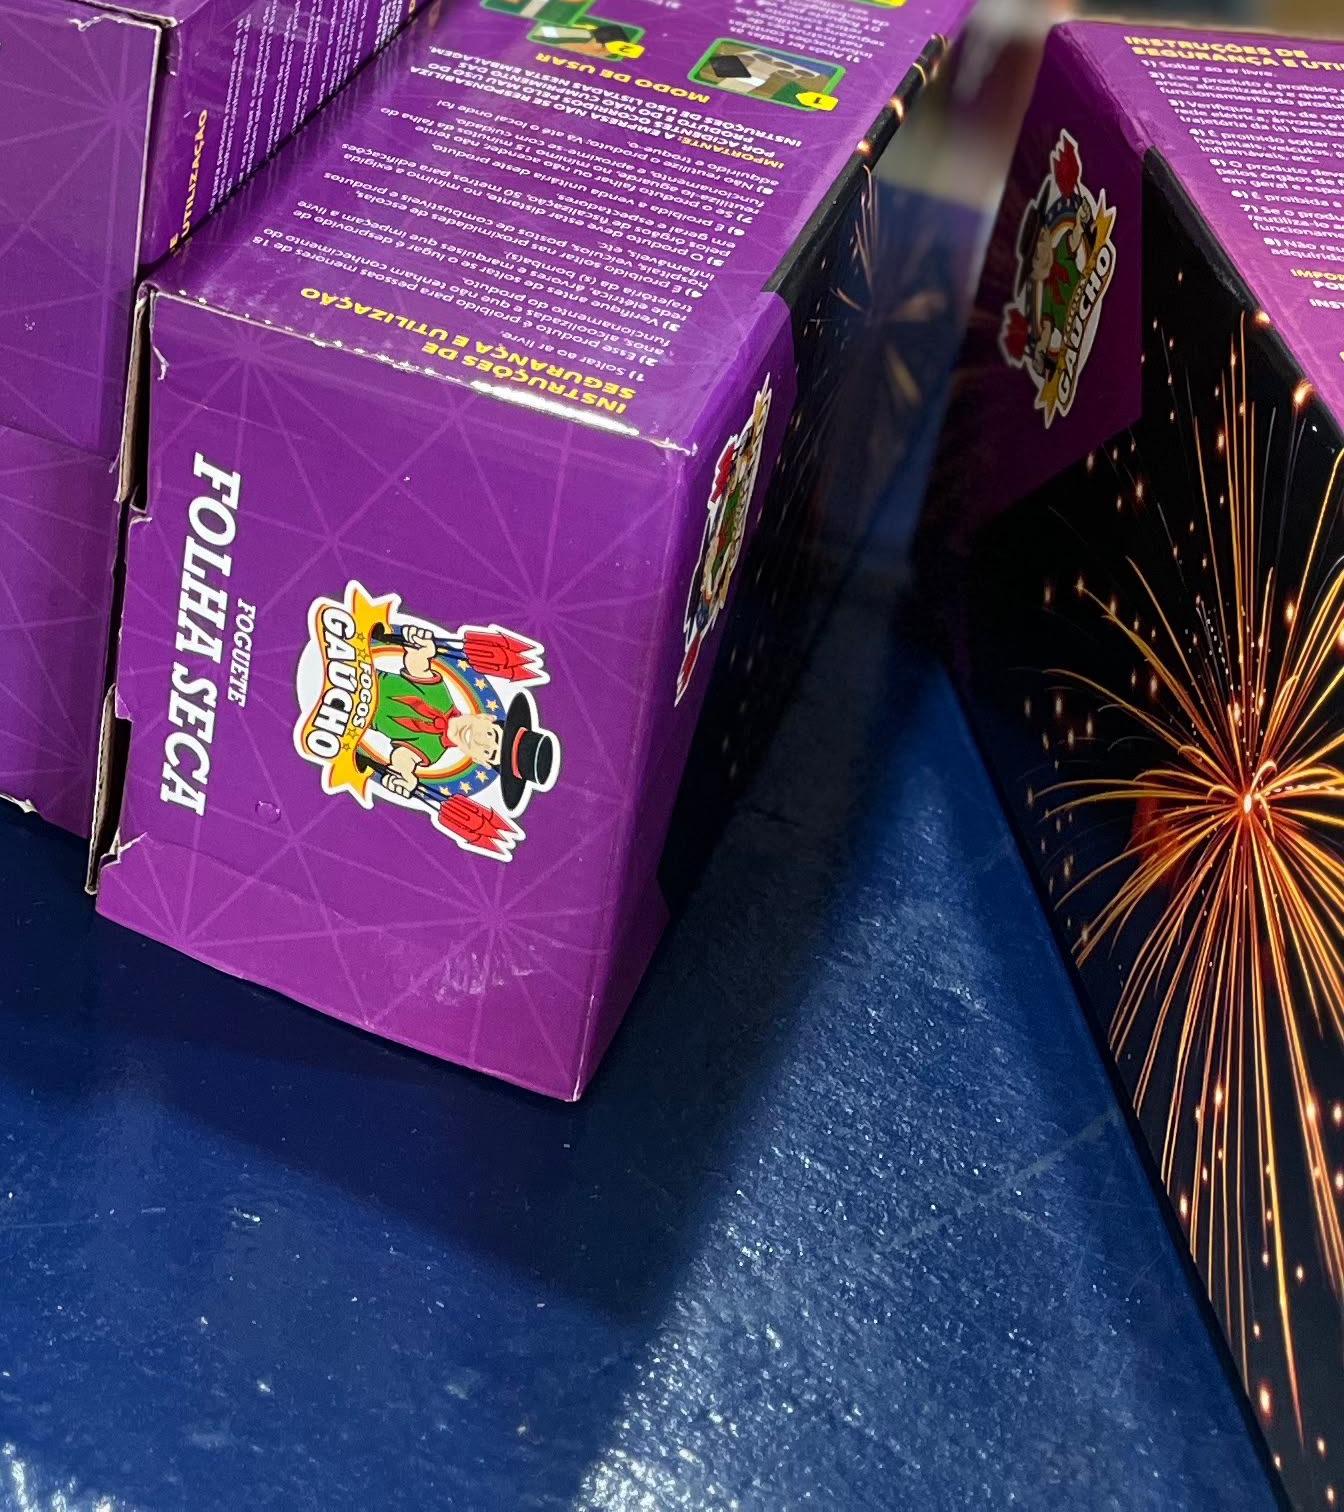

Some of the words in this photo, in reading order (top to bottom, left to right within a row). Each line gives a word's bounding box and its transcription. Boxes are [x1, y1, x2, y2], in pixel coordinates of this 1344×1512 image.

[1124, 35, 1272, 56] INSTRUÇÕES
[1275, 47, 1310, 59] DE
[1131, 46, 1281, 68] SEGURANÇA
[1283, 60, 1299, 69] E
[534, 51, 596, 74] USAR
[598, 67, 632, 83] DE
[633, 77, 711, 103] MODO
[181, 109, 209, 239] UTILIZAÇÃO
[251, 235, 270, 247] 18
[272, 241, 293, 252] de
[293, 247, 358, 272] menores
[358, 267, 419, 291] pessoas
[418, 286, 455, 302] para
[299, 286, 449, 341] UTILIZAÇÃO
[454, 297, 522, 323] proibido
[521, 318, 533, 328] é
[450, 333, 470, 348] E
[499, 329, 535, 348] livre.
[534, 323, 601, 348] produto
[536, 342, 555, 352] ar
[420, 340, 459, 361] DE
[555, 348, 578, 359] ao
[600, 343, 637, 361] Esse
[638, 354, 659, 367] 2)
[474, 339, 636, 399] SEGURANÇA
[578, 355, 626, 376] Soltar
[627, 369, 644, 382] 1)
[460, 353, 627, 414] INSTRUÇÕES
[174, 451, 242, 665] FOLHA
[226, 598, 258, 709] FOGUETE
[306, 605, 355, 760] GAÚCHO
[350, 662, 375, 728] FOGOS
[159, 663, 219, 817] SECA
